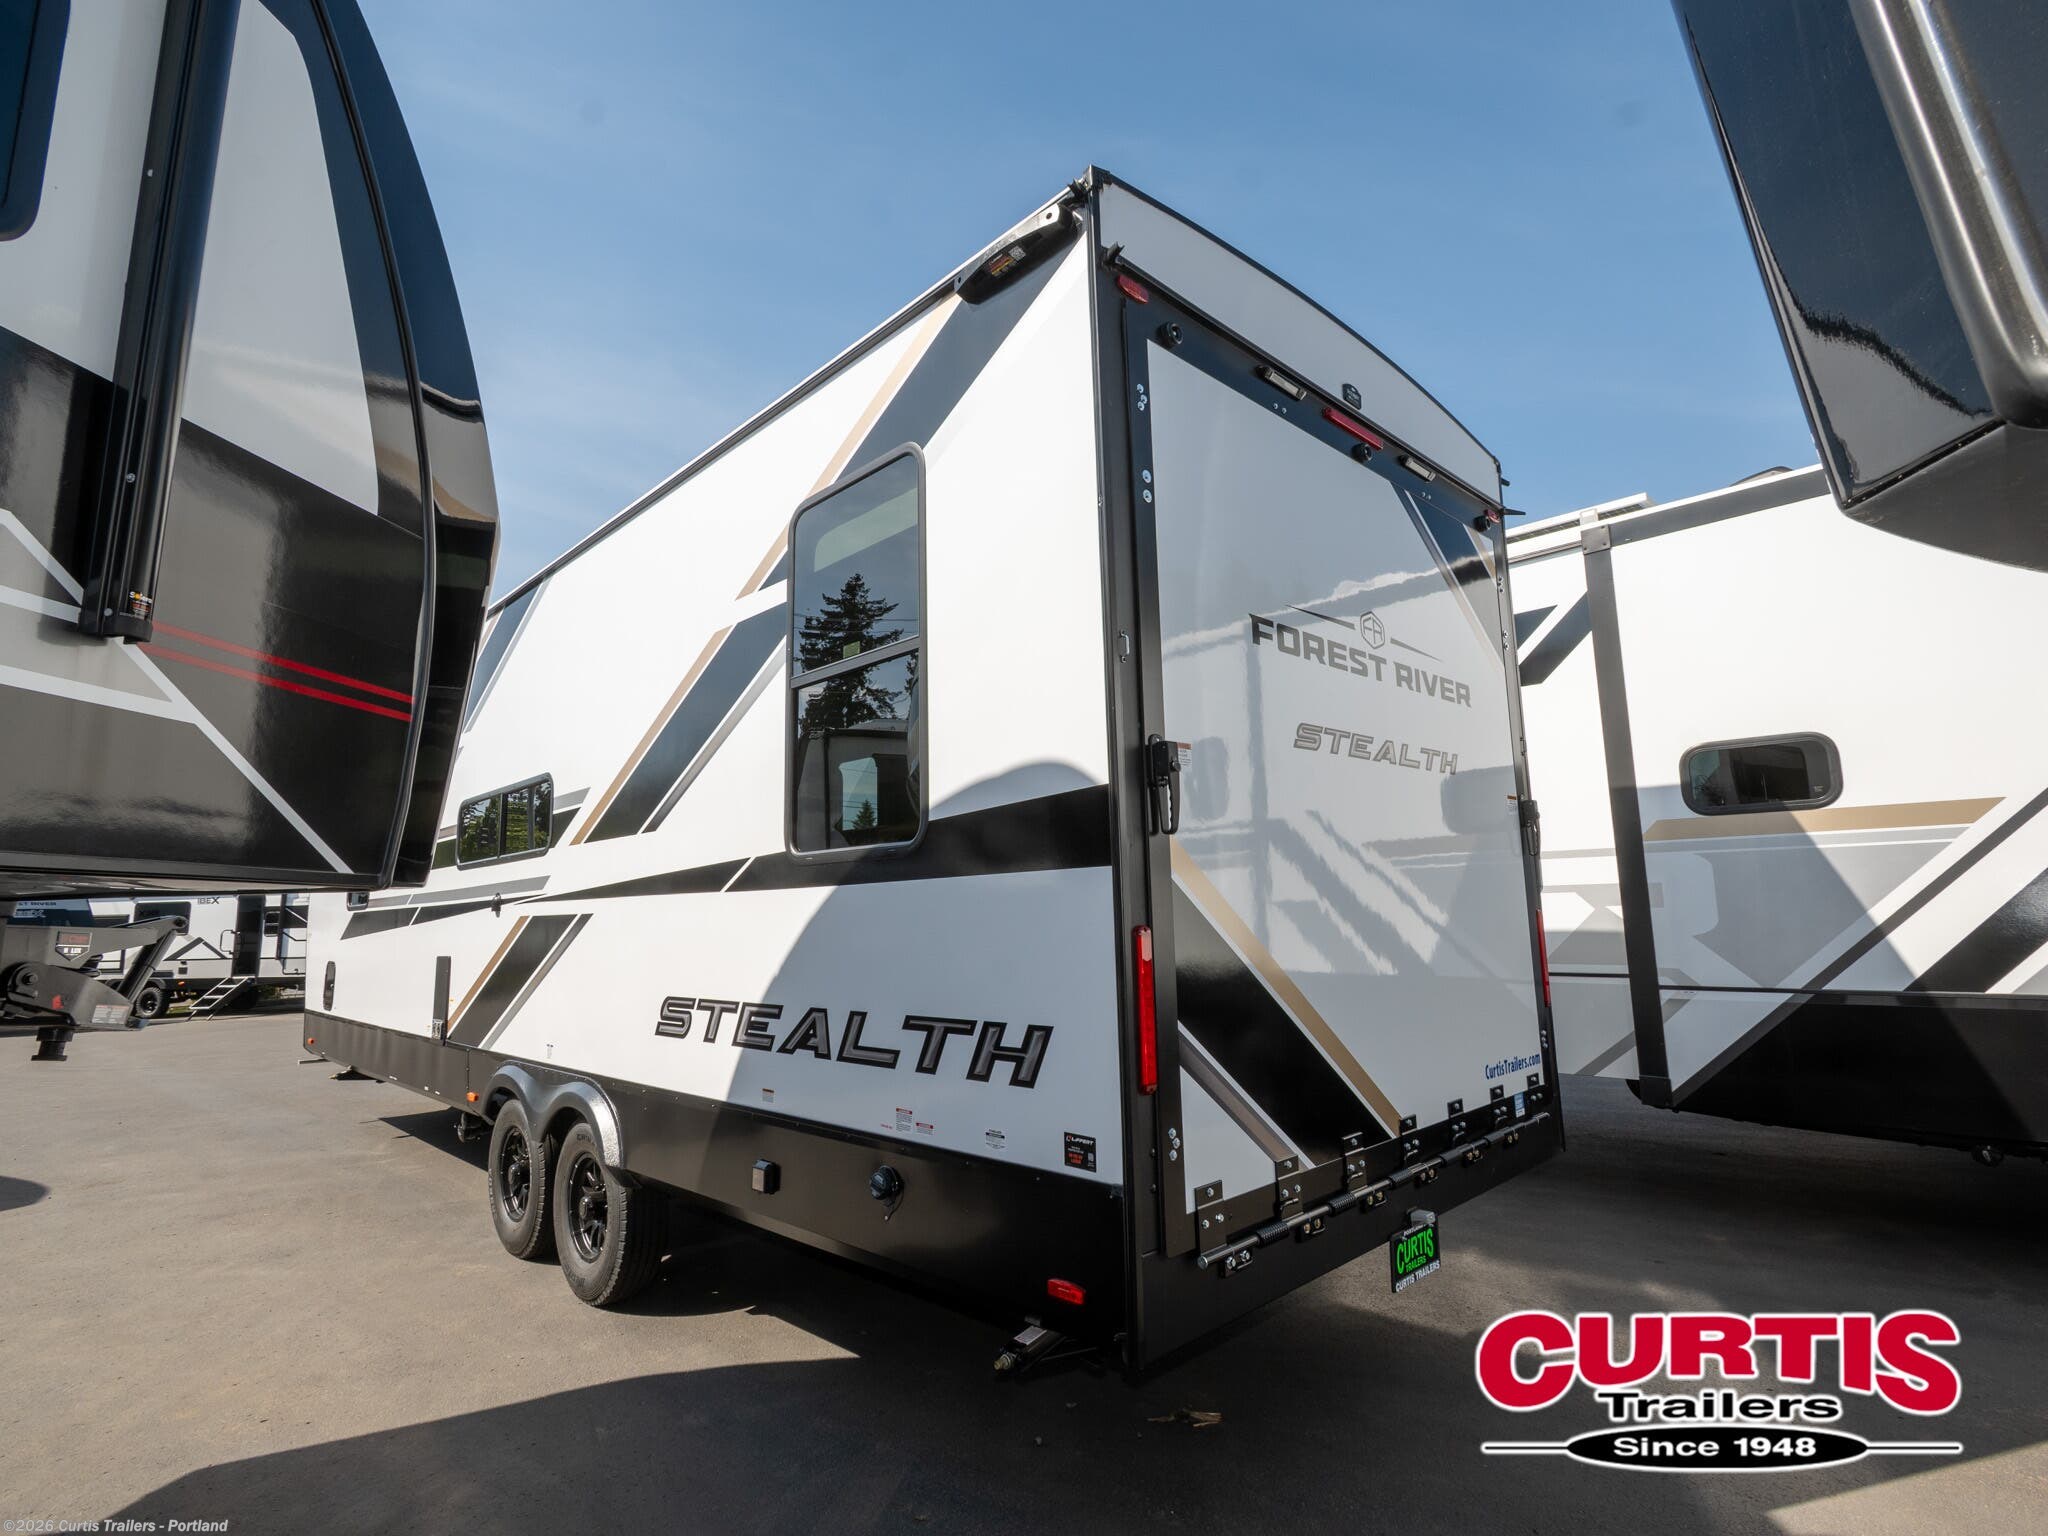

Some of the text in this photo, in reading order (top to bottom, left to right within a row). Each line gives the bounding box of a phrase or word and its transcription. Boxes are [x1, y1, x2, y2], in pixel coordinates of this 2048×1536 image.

[1248, 613, 1473, 708] FOREST RIVER
[1293, 721, 1459, 776] STEALTH
[654, 995, 1055, 1090] STEALTH
[1485, 1053, 1541, 1080] CurtisTrailers.com
[1396, 1228, 1434, 1274] CURTIS
[1395, 1260, 1440, 1293] CURTIS TRAILERS
